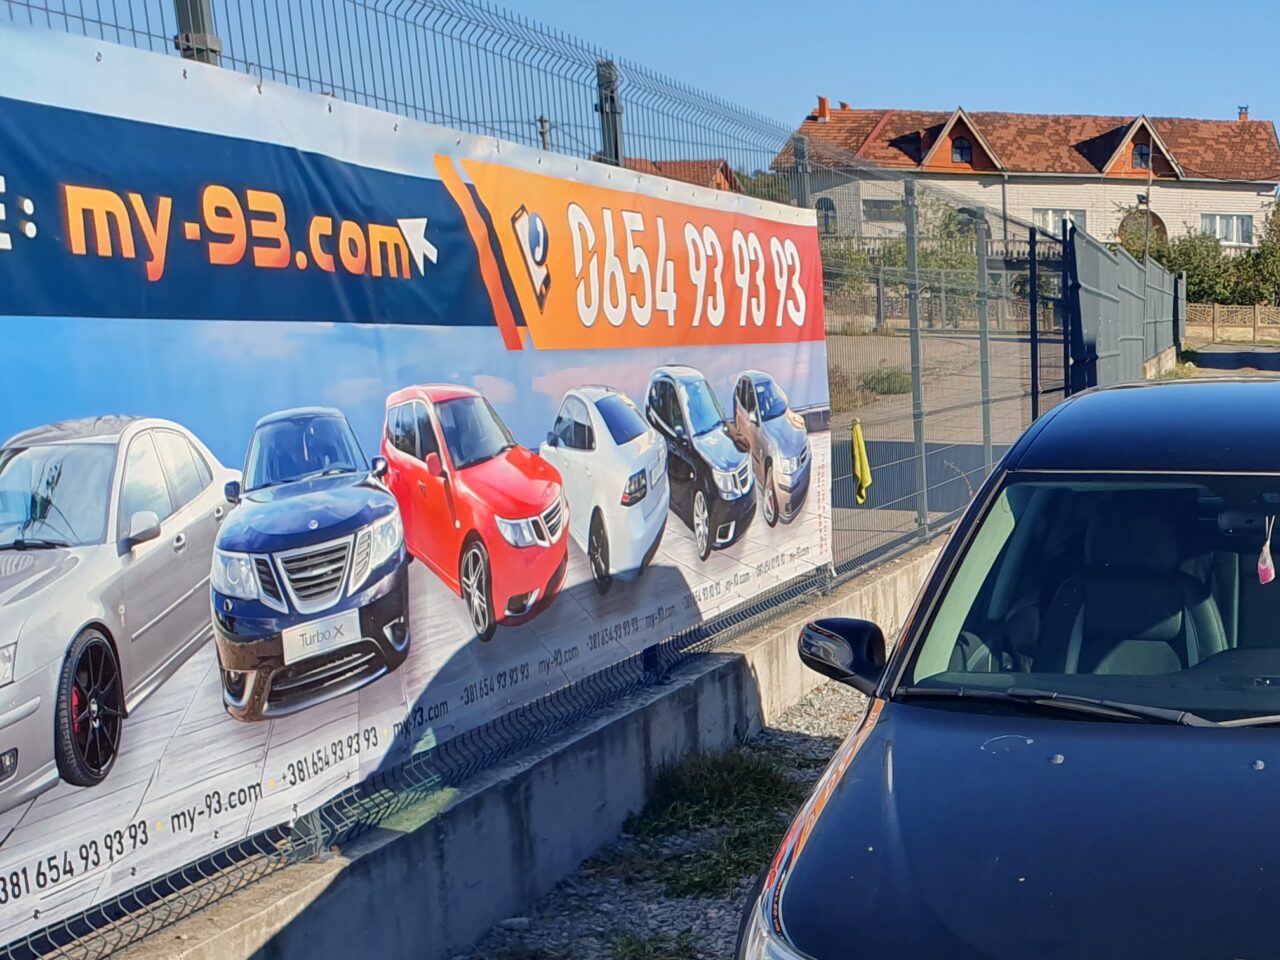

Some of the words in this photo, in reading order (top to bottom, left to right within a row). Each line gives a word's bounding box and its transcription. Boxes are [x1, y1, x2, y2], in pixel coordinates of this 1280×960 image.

[63, 183, 412, 282] my-93.com
[567, 203, 677, 327] 0654
[684, 222, 725, 327] 93
[732, 229, 766, 327] 93
[770, 236, 807, 327] 93
[299, 629, 331, 647] Turbo
[333, 624, 344, 638] X
[496, 669, 507, 688] 93
[509, 666, 519, 686] 93
[520, 662, 530, 680] 93
[331, 739, 345, 764] 93
[347, 733, 360, 757] 93
[363, 726, 378, 750] 93
[35, 851, 75, 888] 654
[79, 840, 101, 873] 93
[104, 830, 125, 864] 93
[128, 820, 149, 850] 93
[170, 782, 263, 833] my-93.com
